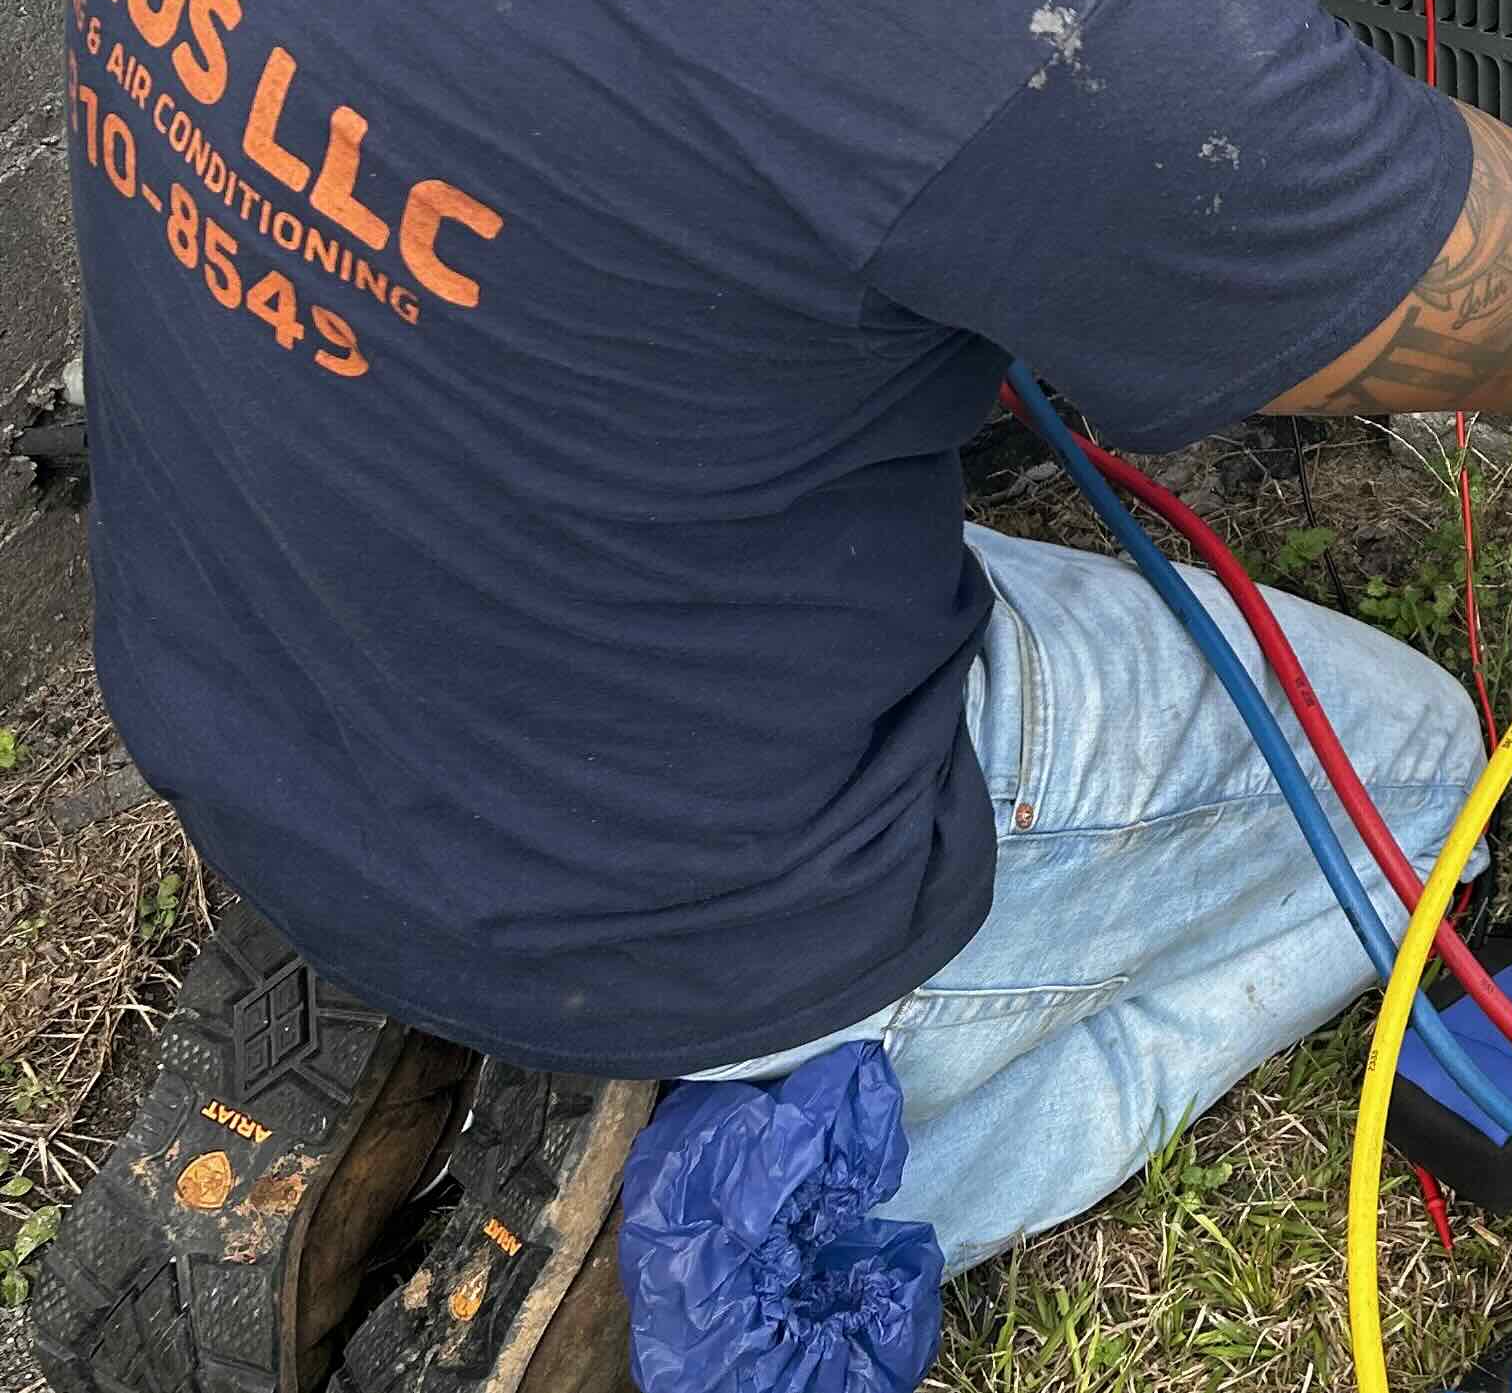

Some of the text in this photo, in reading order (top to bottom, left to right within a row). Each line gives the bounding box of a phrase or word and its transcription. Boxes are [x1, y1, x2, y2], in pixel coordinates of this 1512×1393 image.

[69, 48, 369, 377] 10-8549
[87, 16, 419, 326] & AIR CONDITIONING
[242, 45, 504, 308] LLC
[201, 1100, 273, 1144] ARIAT
